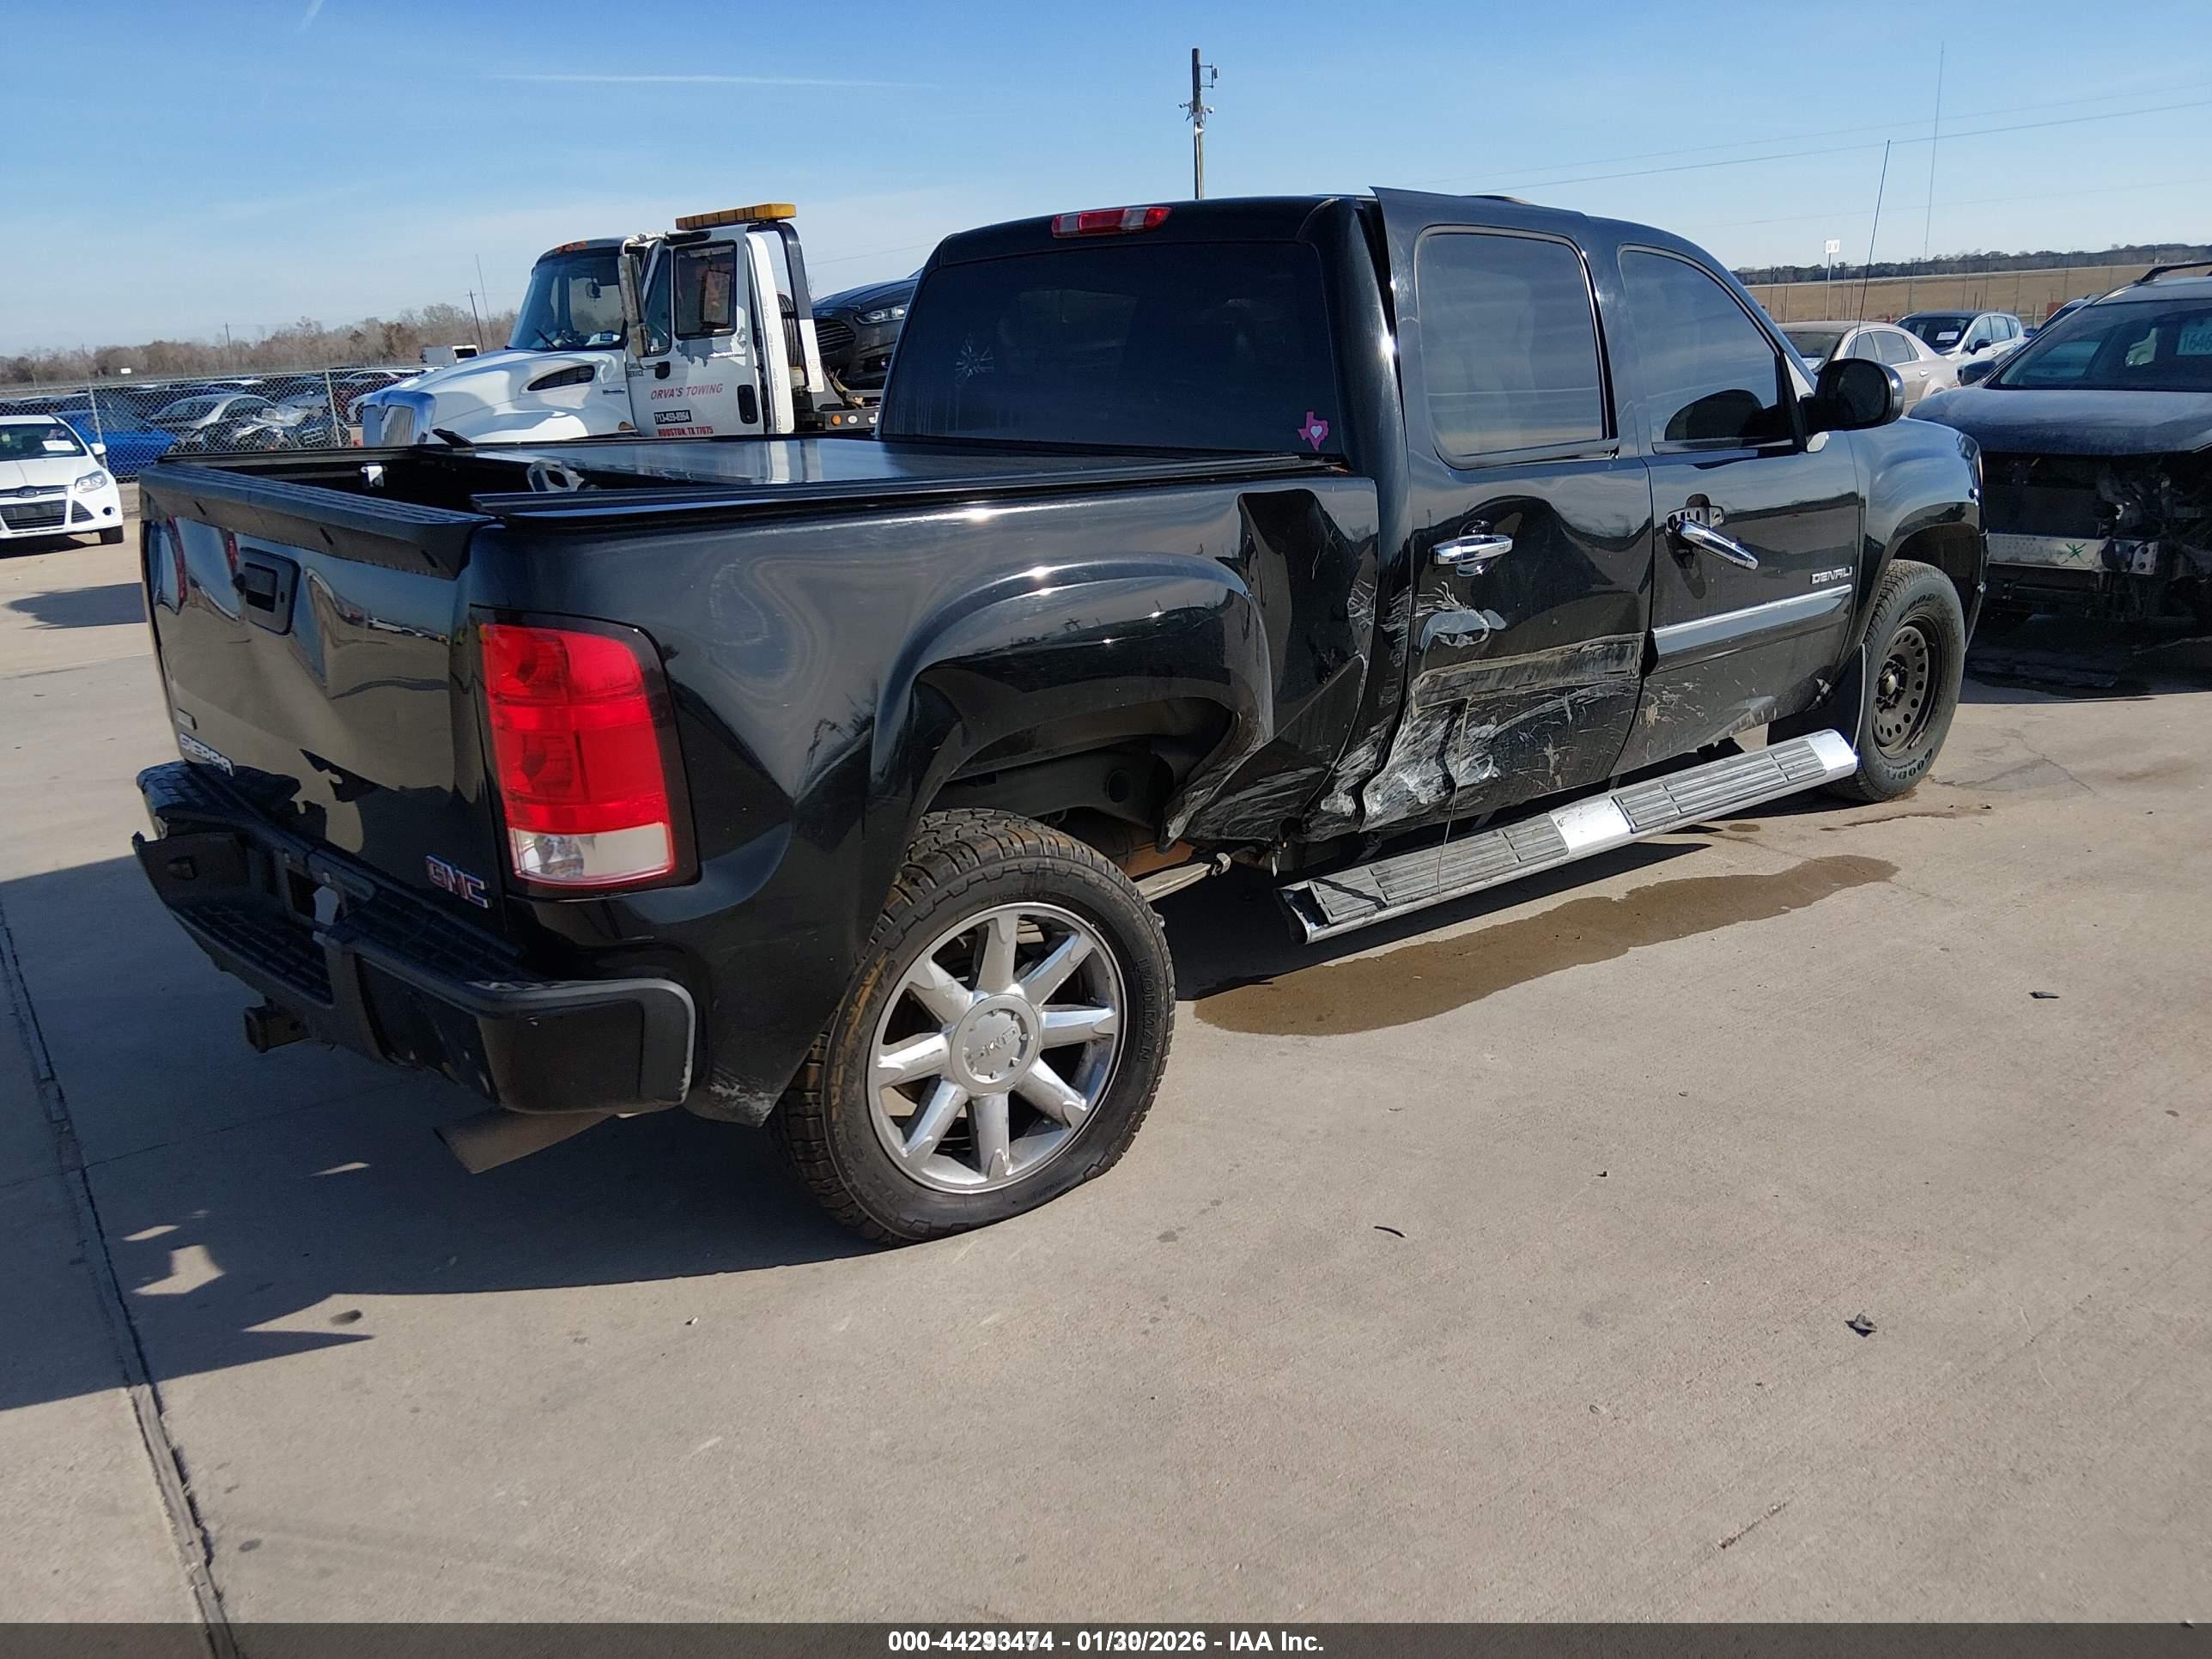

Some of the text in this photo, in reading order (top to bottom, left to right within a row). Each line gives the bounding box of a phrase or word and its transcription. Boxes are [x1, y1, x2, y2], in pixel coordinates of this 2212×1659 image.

[651, 383, 724, 400] ORVA'S TOWING
[1811, 566, 1853, 585] DENALI
[179, 732, 234, 777] SIERRA
[425, 854, 489, 909] GMC
[1136, 956, 1157, 1063] IRONMAN
